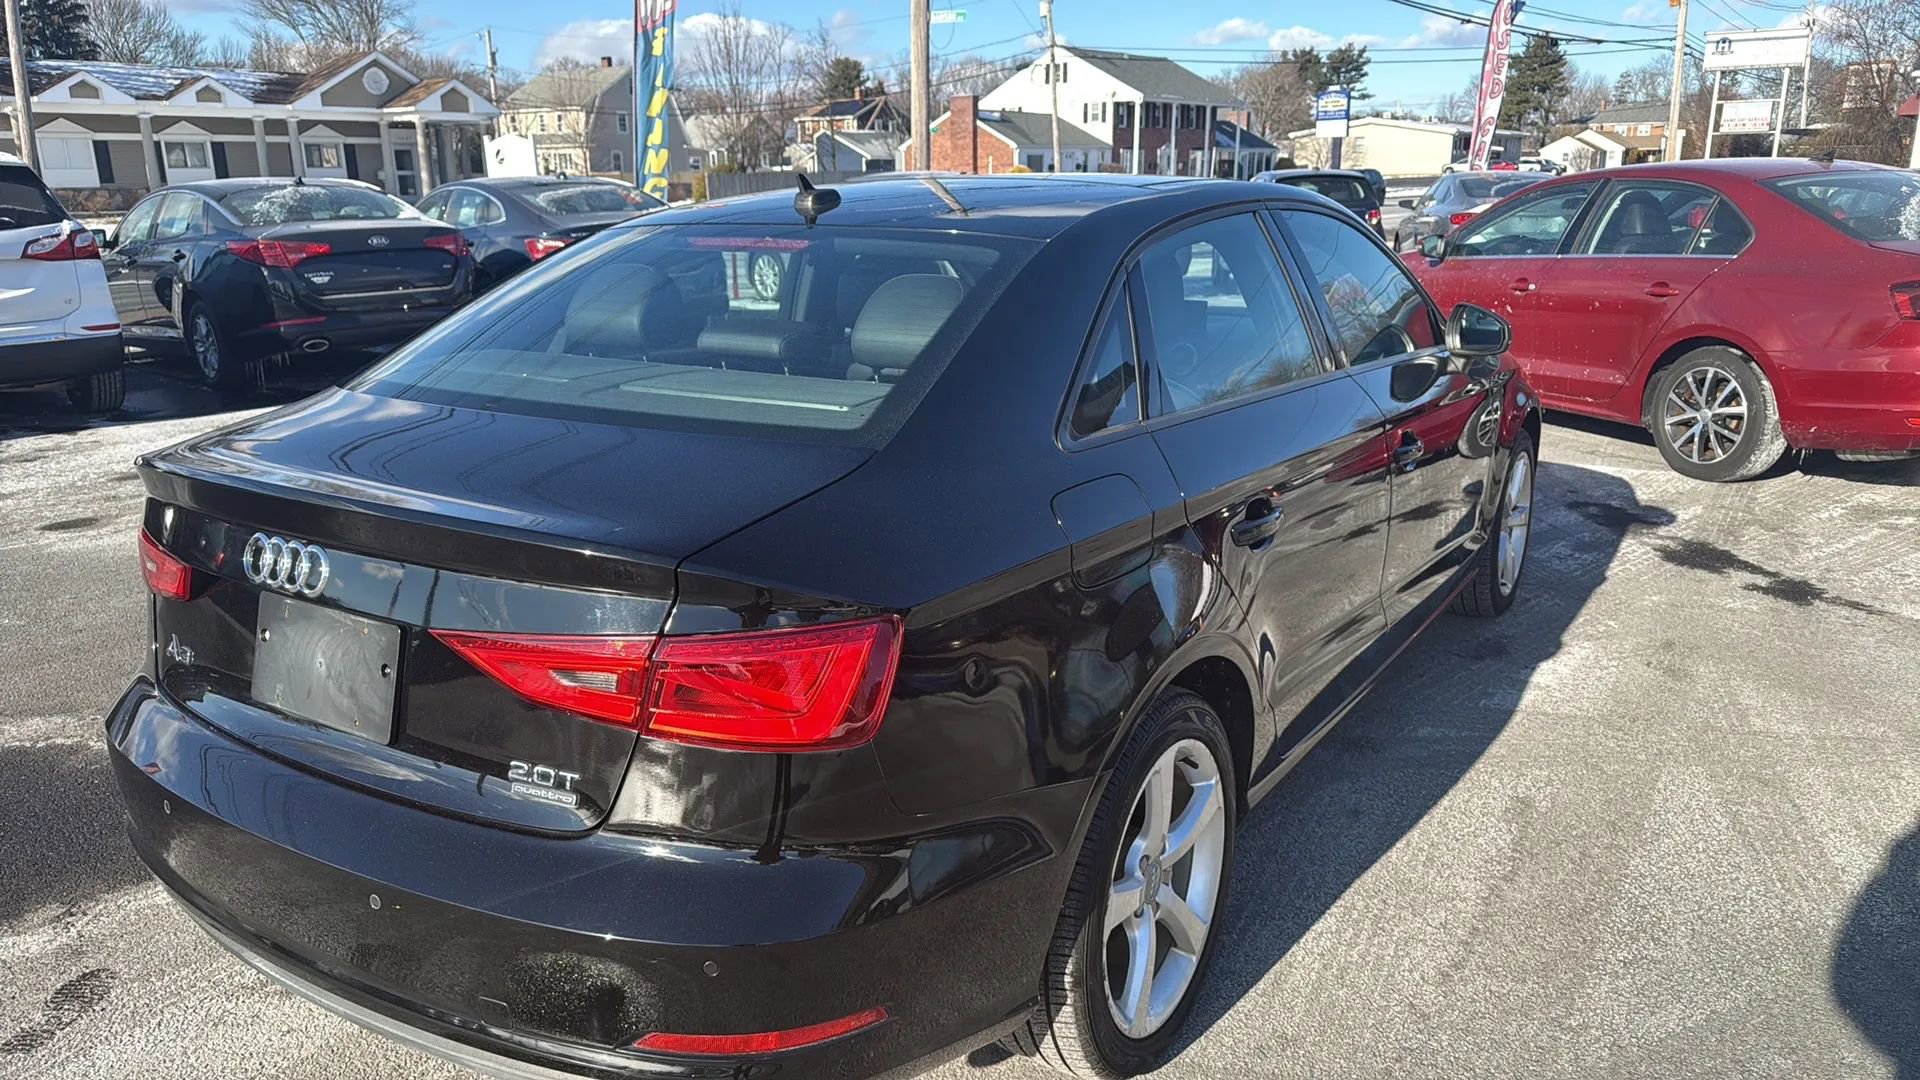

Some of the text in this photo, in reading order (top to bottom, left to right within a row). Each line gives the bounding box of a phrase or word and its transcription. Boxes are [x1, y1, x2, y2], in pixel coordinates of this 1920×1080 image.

[1489, 2, 1512, 99] USED
[508, 760, 581, 791] 2.0T
[512, 783, 576, 806] quattro
